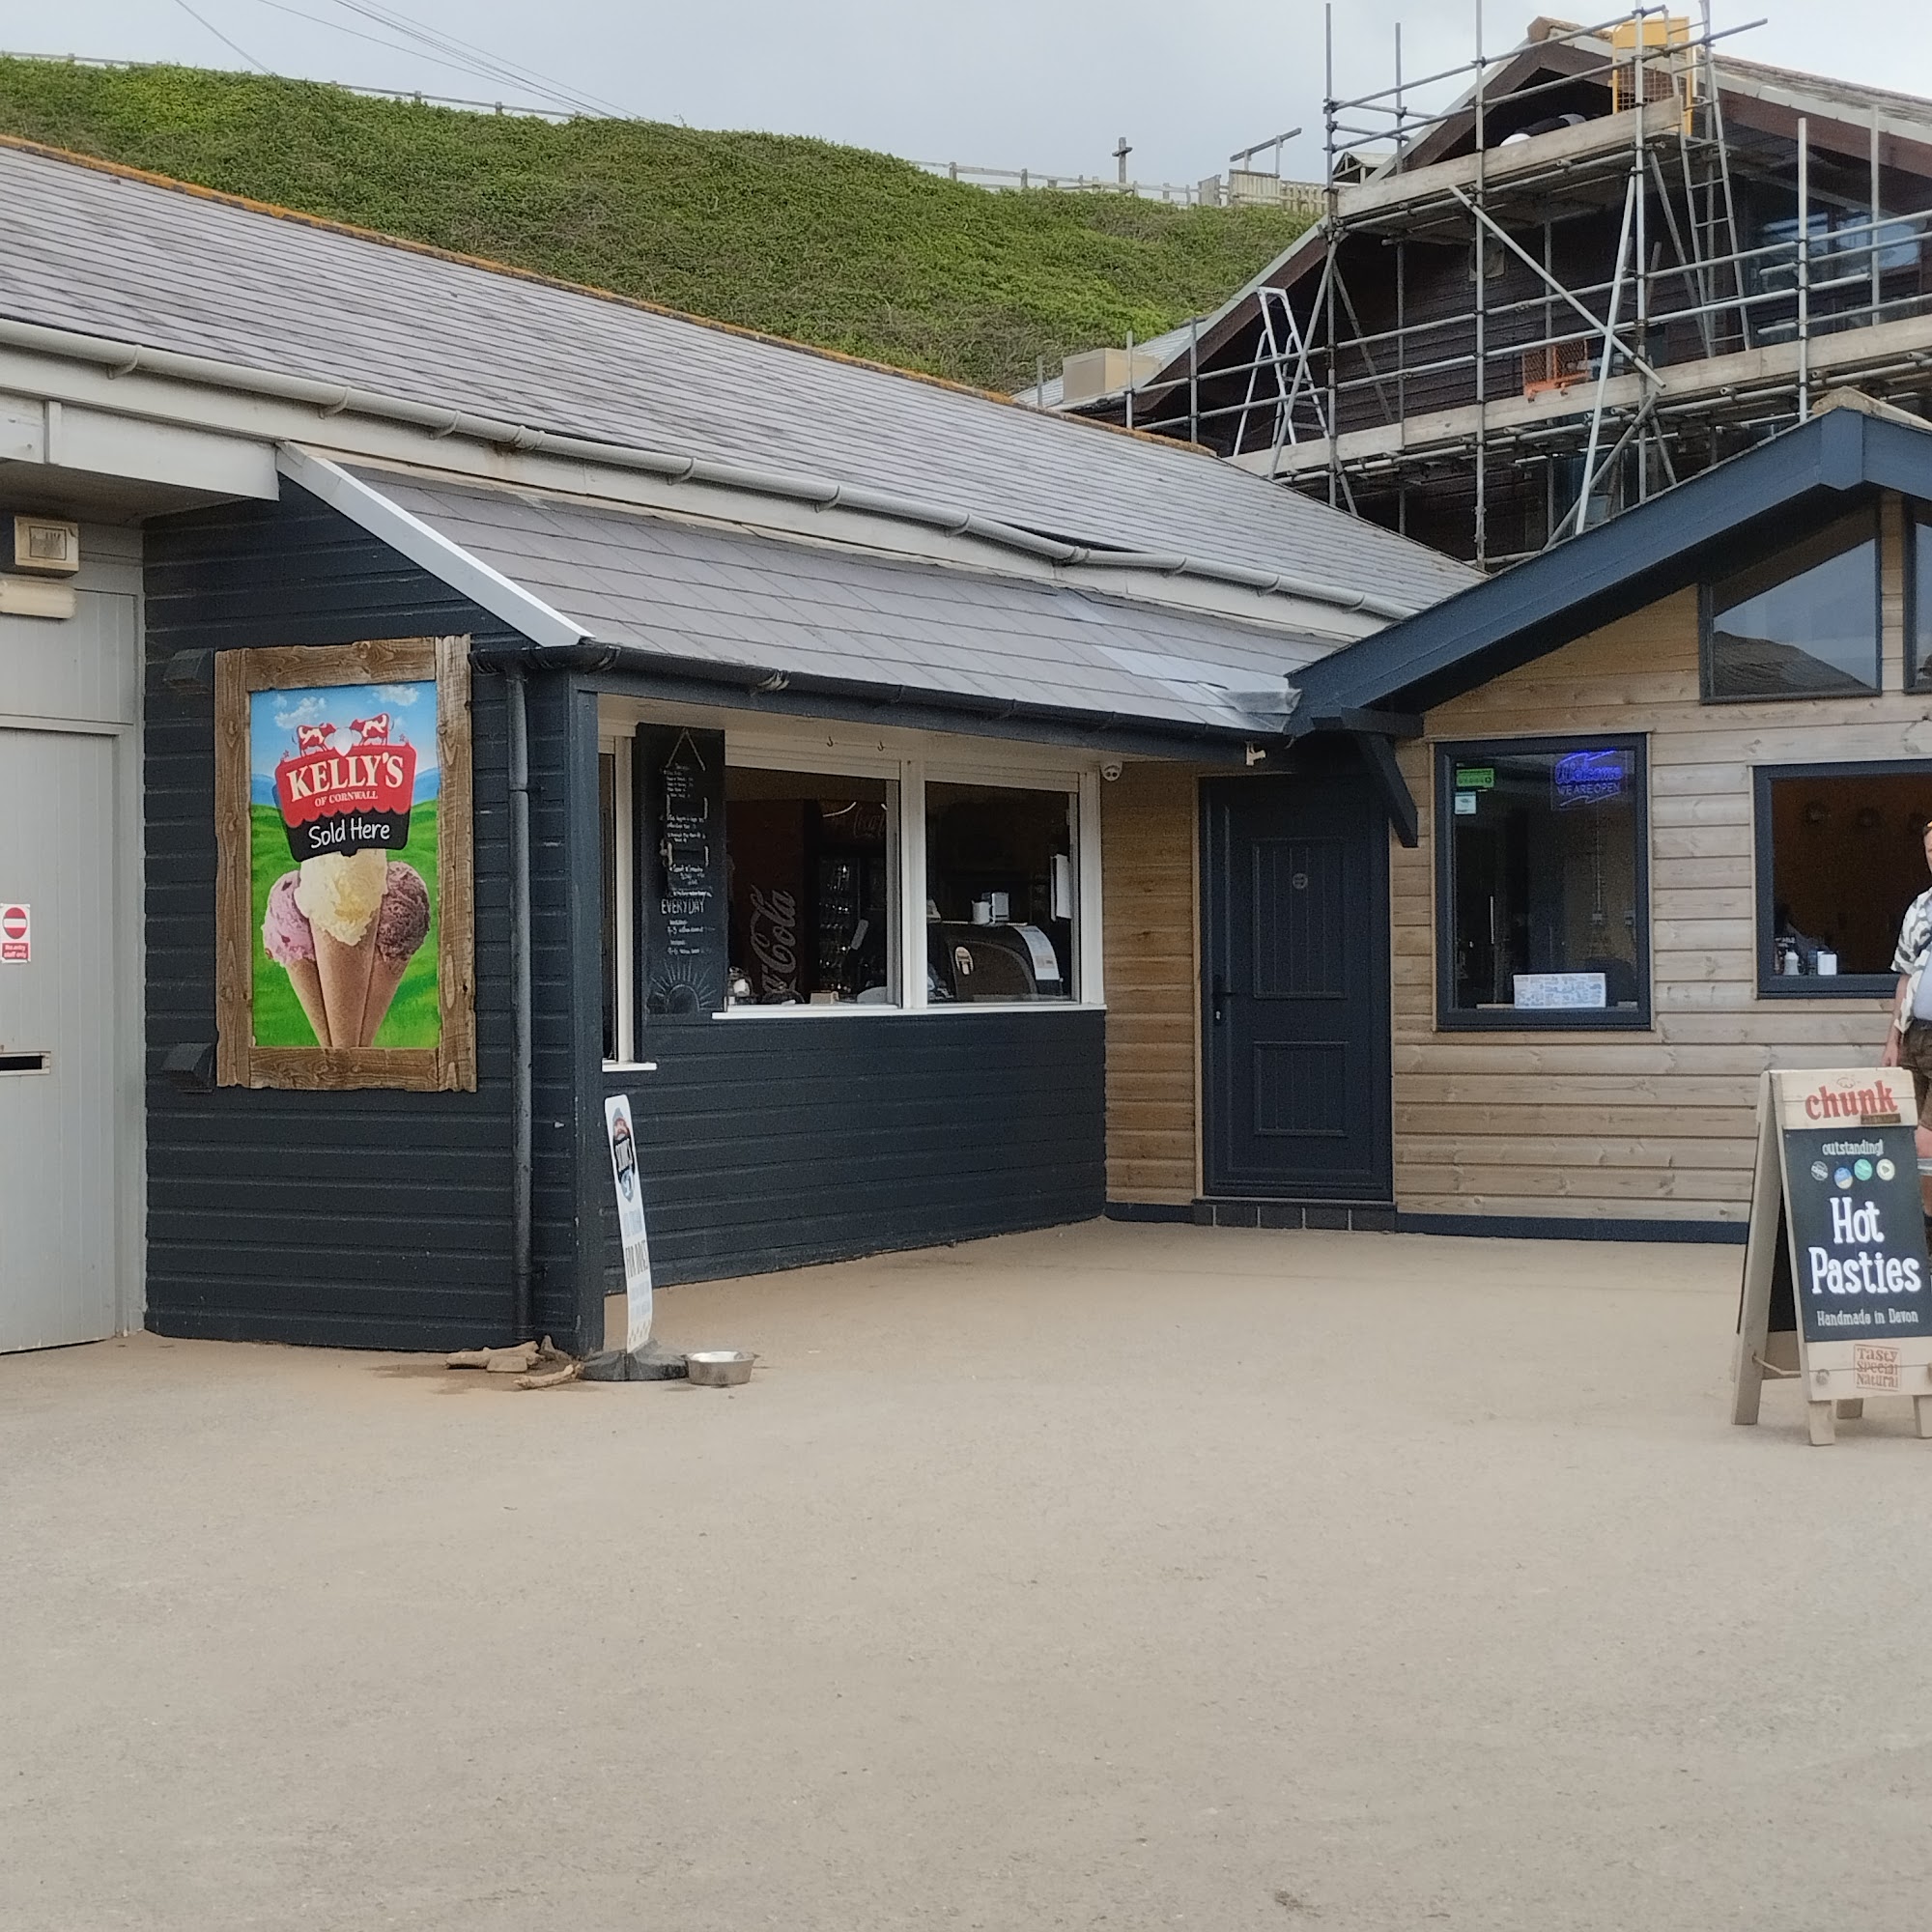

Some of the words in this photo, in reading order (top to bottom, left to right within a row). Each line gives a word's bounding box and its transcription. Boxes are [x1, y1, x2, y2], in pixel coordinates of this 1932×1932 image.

[286, 752, 404, 803] KELLY'S
[1557, 785, 1573, 795] WE
[1574, 783, 1593, 795] ARE
[1593, 781, 1620, 794] OPEN
[314, 796, 327, 808] OF
[328, 790, 379, 804] CORNWALL
[308, 819, 346, 849] Sold
[350, 817, 391, 840] Here
[661, 898, 705, 915] EVERYDAY
[1804, 1080, 1898, 1121] chunk
[1830, 1196, 1885, 1244] Hot
[1808, 1246, 1922, 1294] Pasties
[1816, 1308, 1871, 1326] Handmade
[1874, 1310, 1886, 1324] in
[1889, 1307, 1919, 1323] Devon
[1857, 1348, 1899, 1362] Tasty
[1856, 1374, 1899, 1389] Natural
